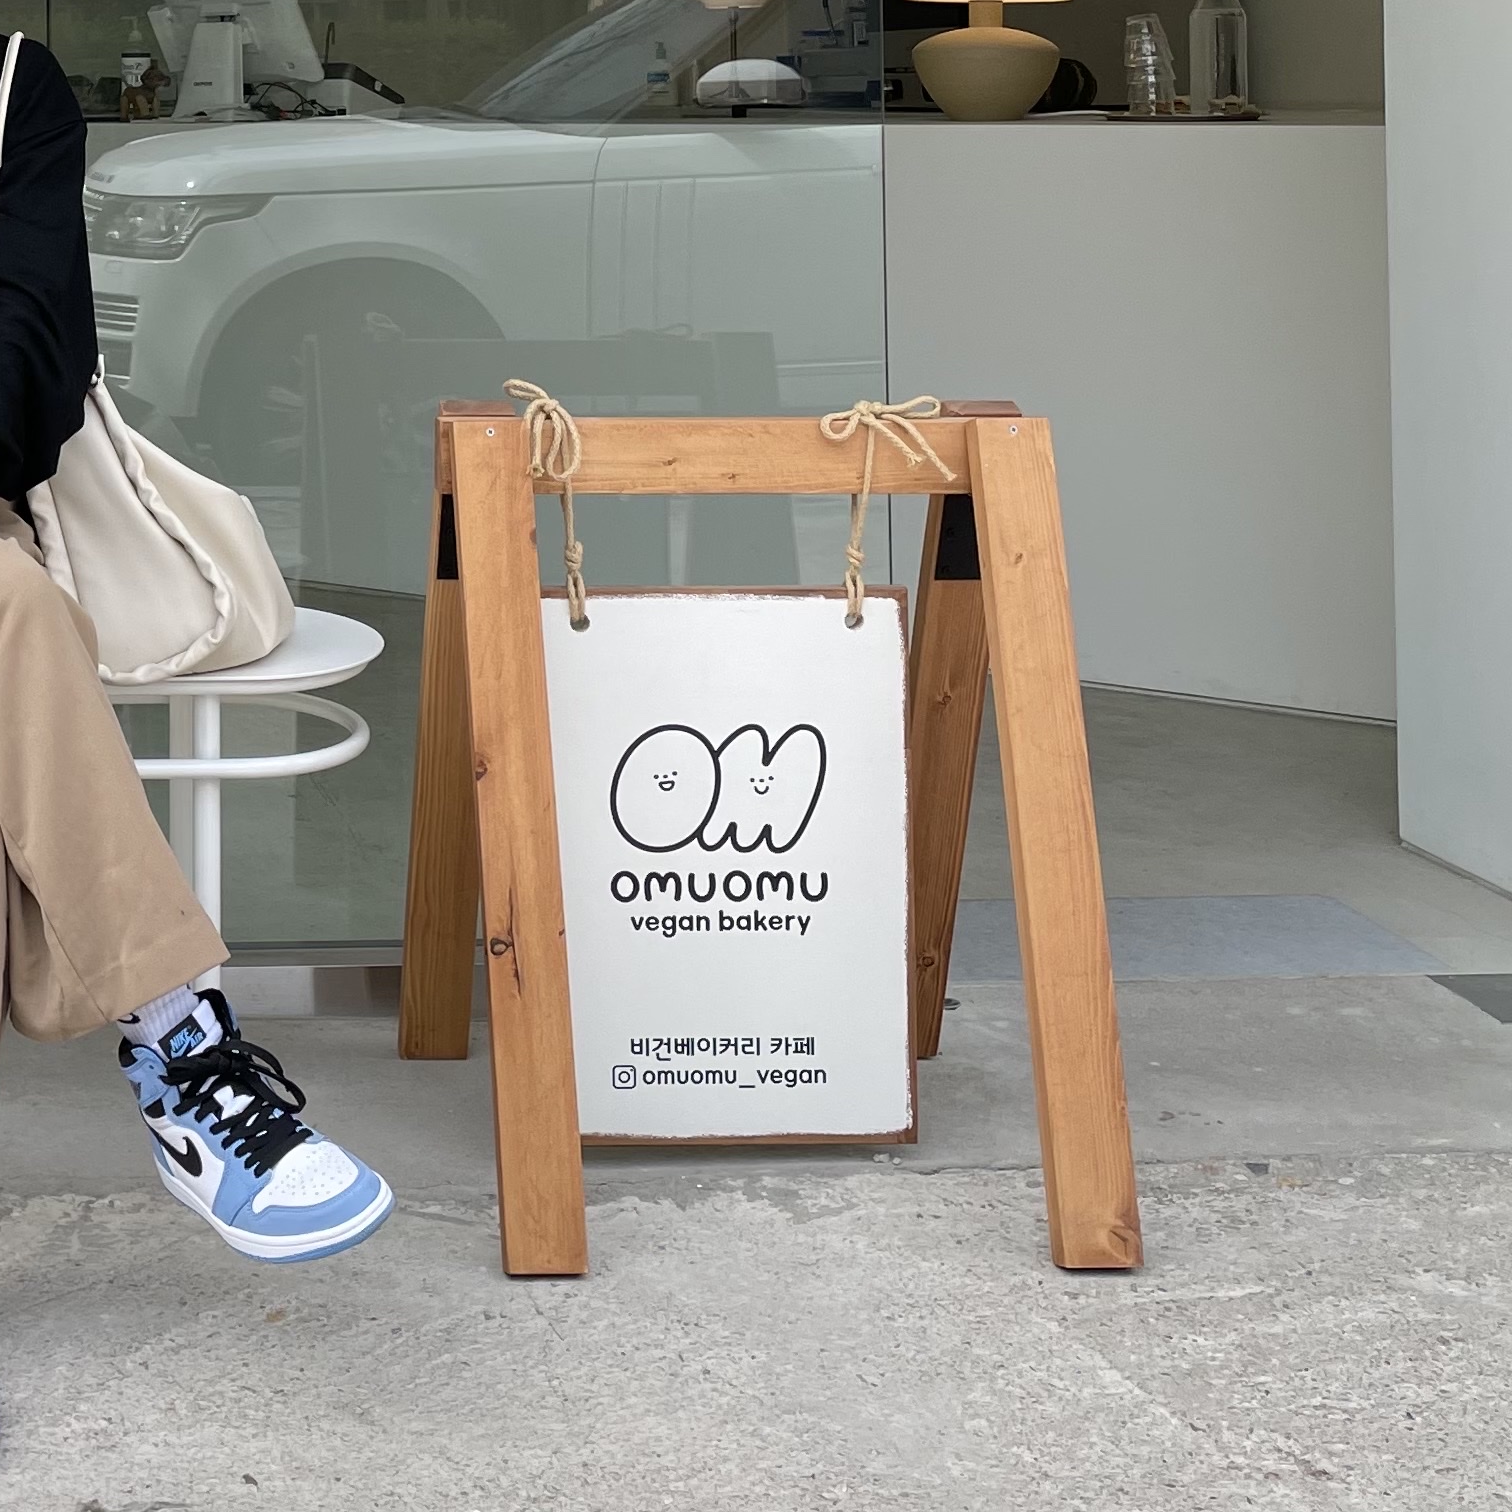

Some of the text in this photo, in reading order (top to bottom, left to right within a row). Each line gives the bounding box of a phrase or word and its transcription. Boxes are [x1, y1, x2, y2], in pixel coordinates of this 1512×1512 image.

[630, 909, 811, 938] vegan bakery
[630, 1036, 815, 1062] 비건베이커리 카페
[642, 1068, 827, 1088] omuomu_vegan
